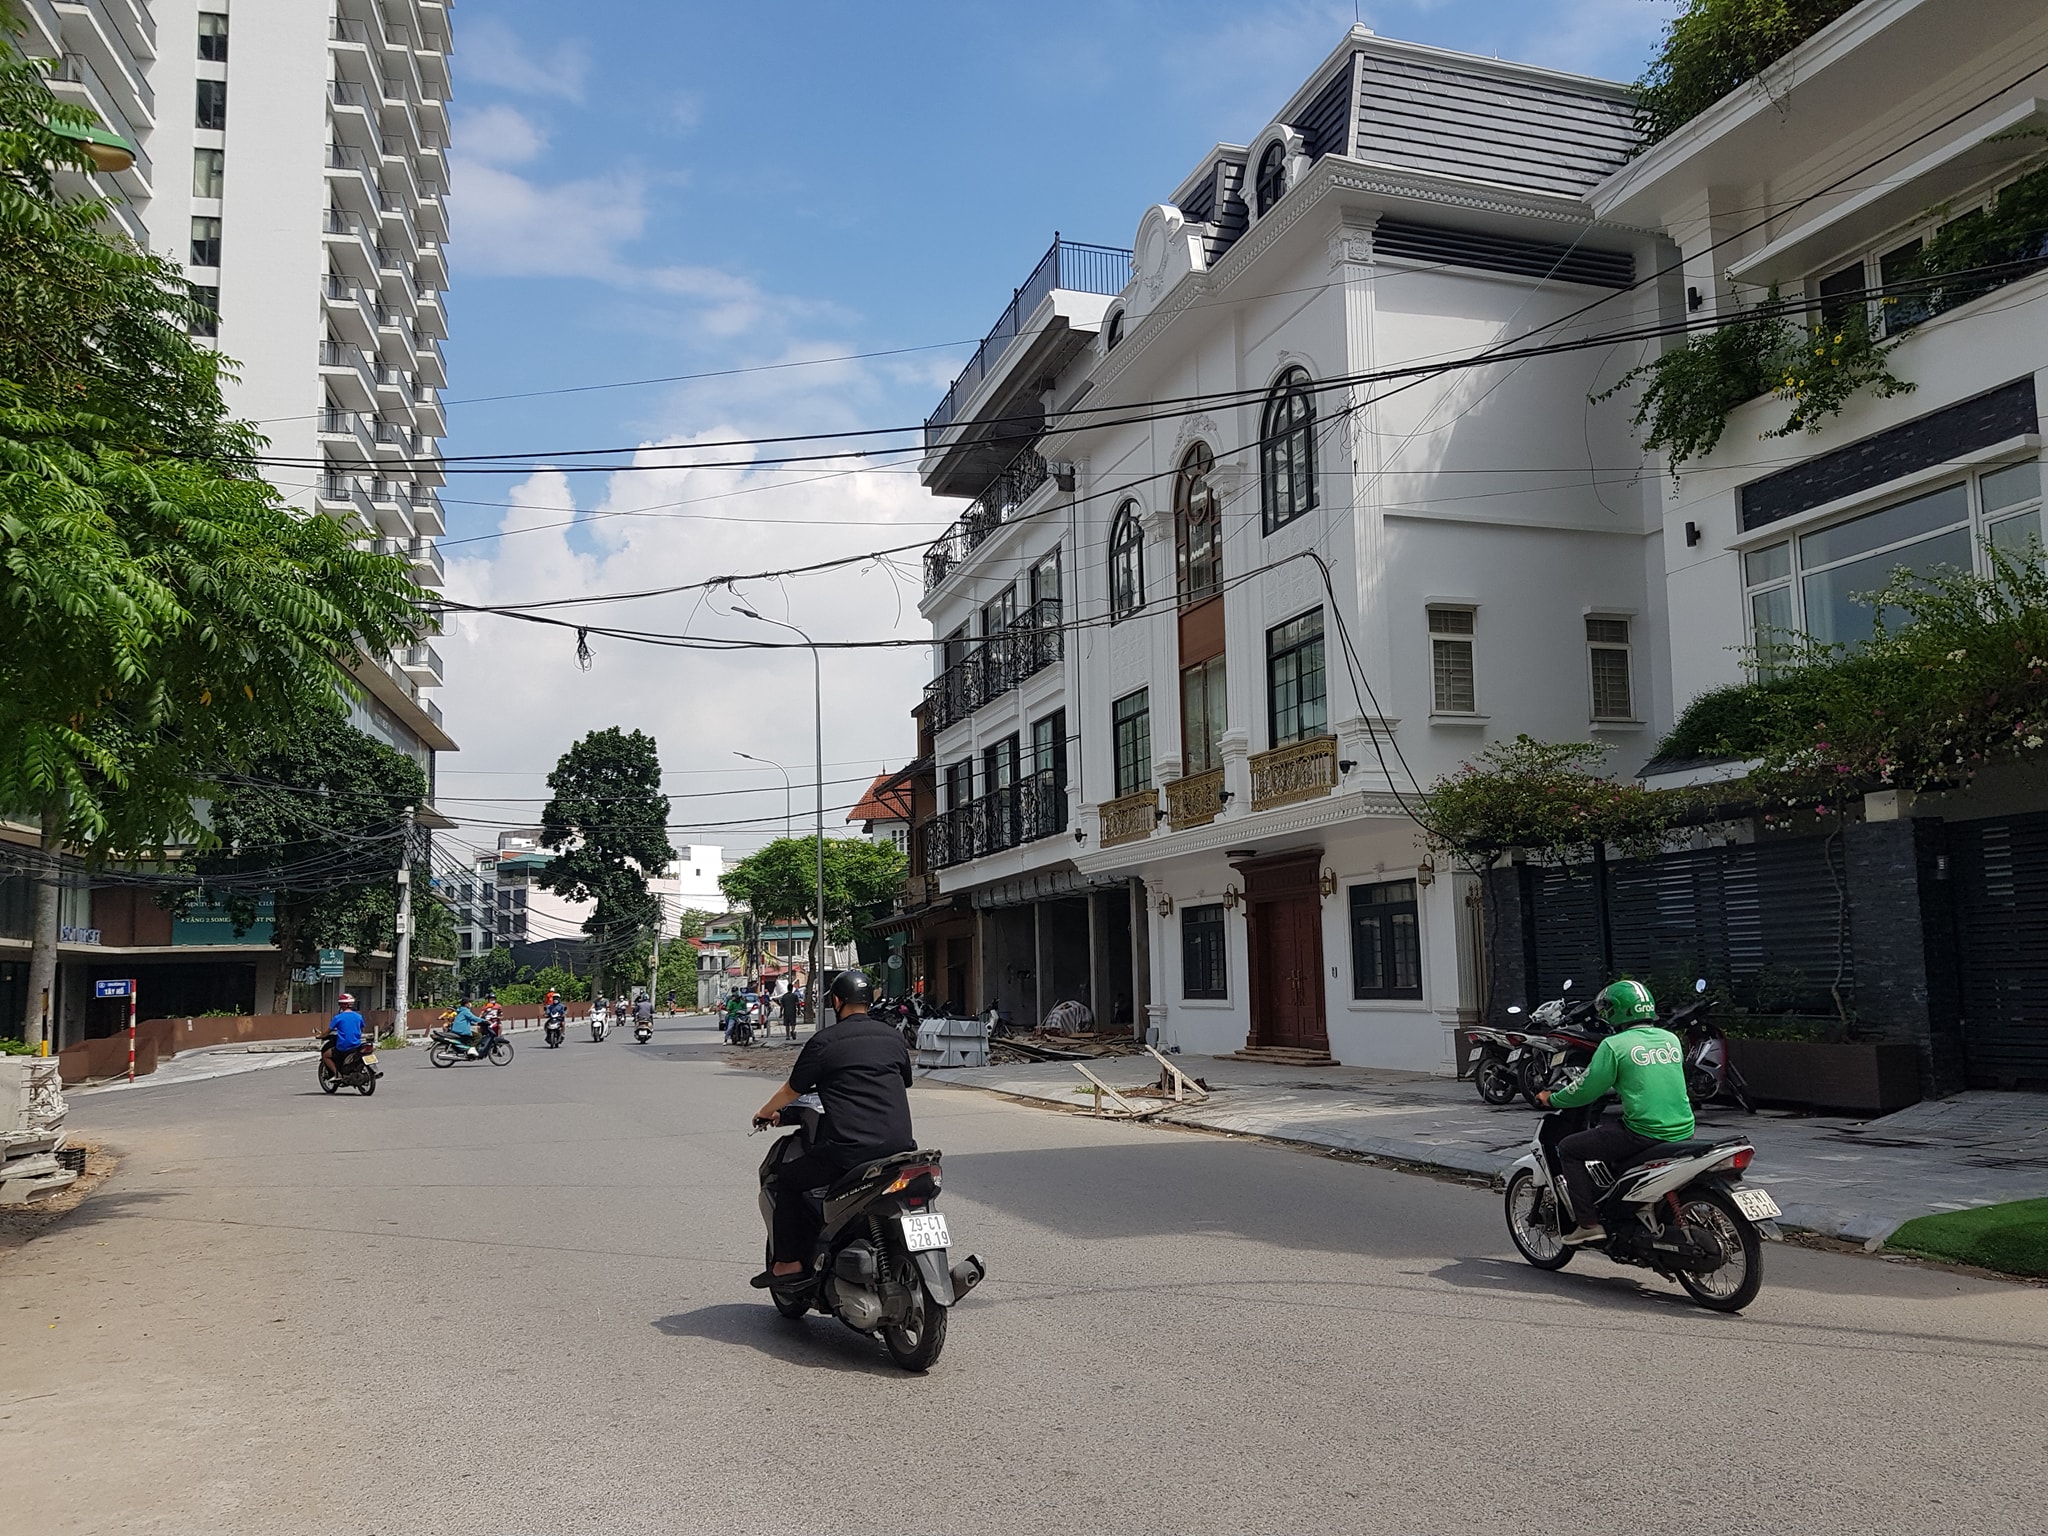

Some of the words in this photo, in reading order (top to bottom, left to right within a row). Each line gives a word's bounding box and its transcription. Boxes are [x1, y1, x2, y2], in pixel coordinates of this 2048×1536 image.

[1634, 1002, 1655, 1013] Grab
[1630, 1041, 1681, 1066] Grab
[908, 1216, 941, 1232] 29-C1
[908, 1231, 949, 1249] 528.19
